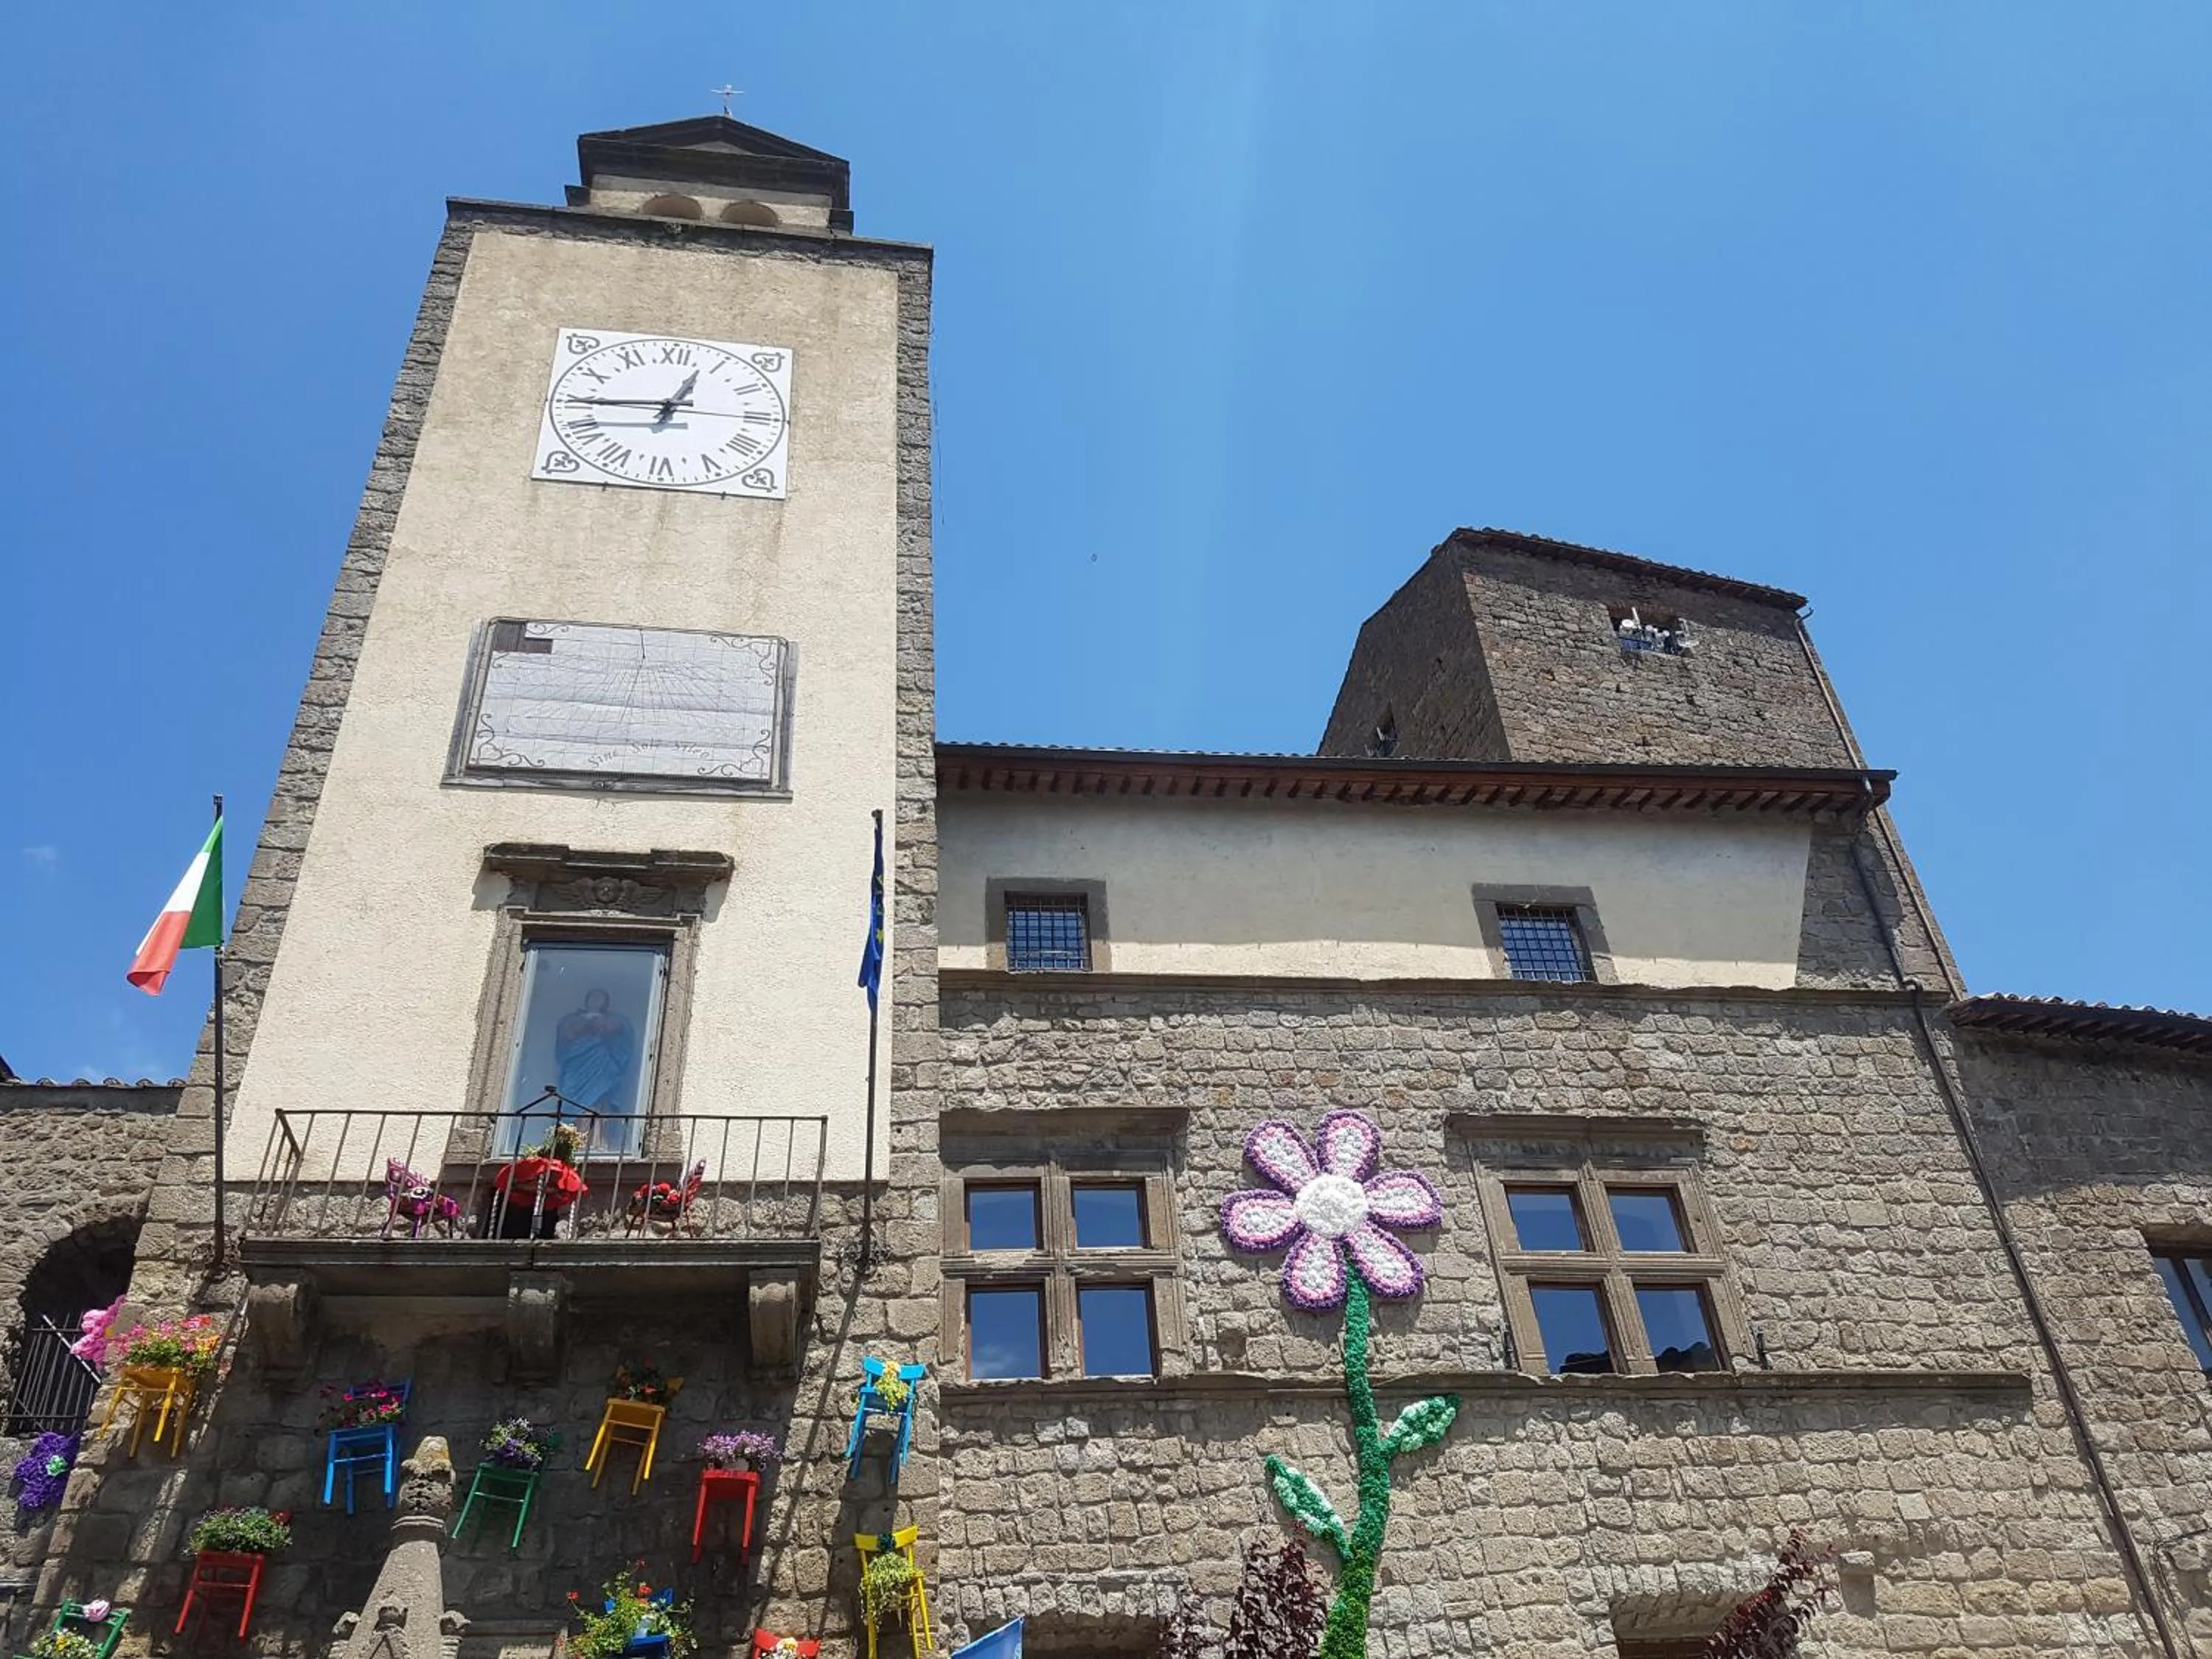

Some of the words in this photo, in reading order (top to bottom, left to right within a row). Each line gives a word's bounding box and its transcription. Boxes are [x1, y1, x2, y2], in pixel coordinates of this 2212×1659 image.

[617, 349, 644, 369] XI
[661, 347, 690, 366] XII
[582, 368, 611, 384] X
[709, 360, 726, 374] I
[733, 383, 762, 395] II
[742, 411, 772, 425] III
[566, 417, 605, 446] VIII
[597, 442, 632, 467] VII
[726, 434, 762, 456] IIII
[649, 456, 673, 476] VI
[701, 453, 721, 473] V
